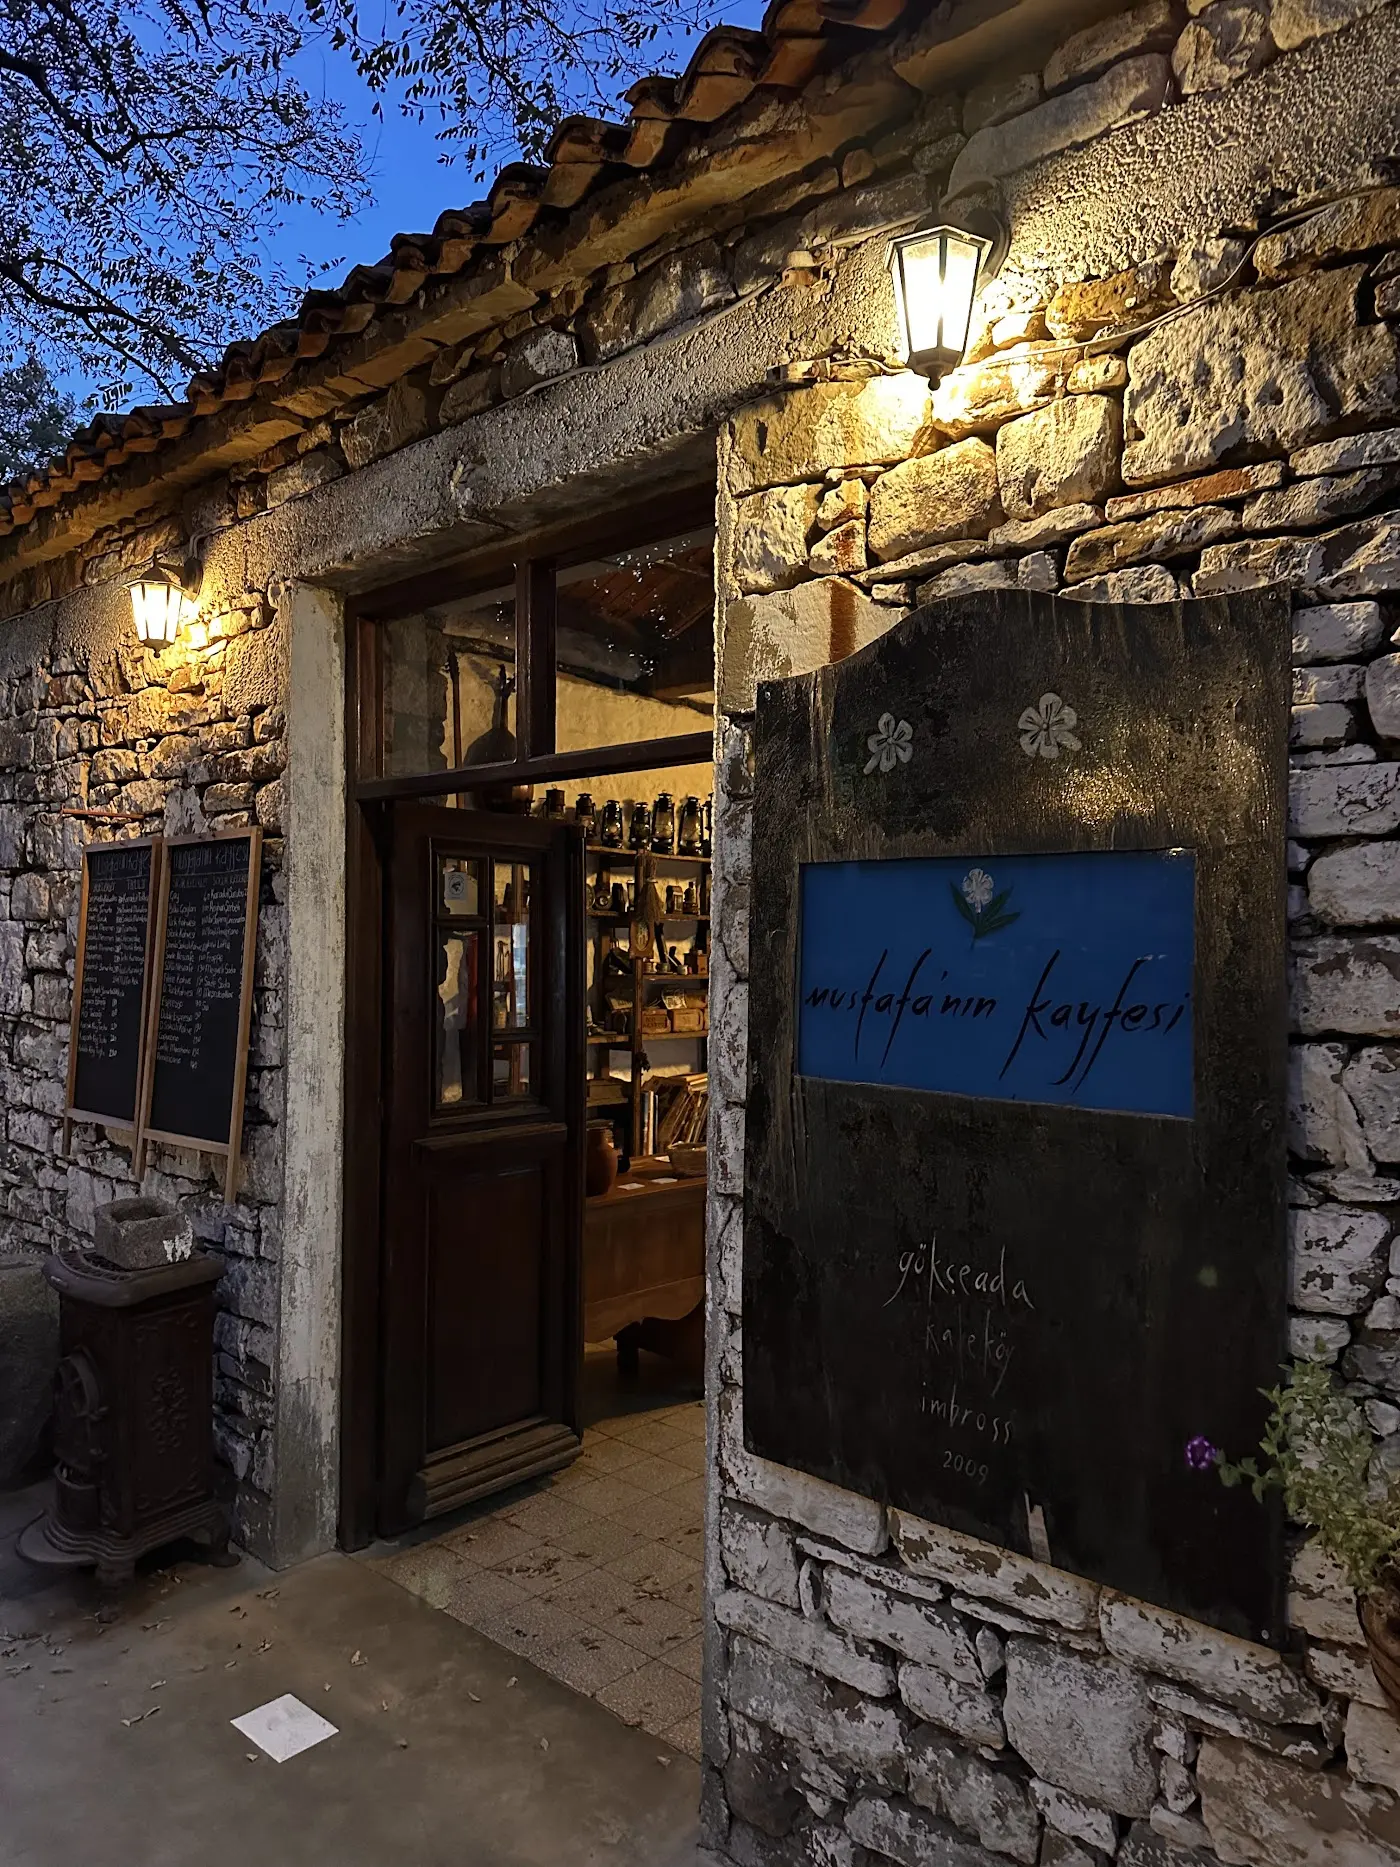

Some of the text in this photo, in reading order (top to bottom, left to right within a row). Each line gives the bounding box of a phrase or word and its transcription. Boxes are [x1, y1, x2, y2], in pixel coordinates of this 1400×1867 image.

[999, 949, 1191, 1094] kayfesi
[882, 1235, 1036, 1310] gökçeada
[942, 1450, 989, 1485] 2009
